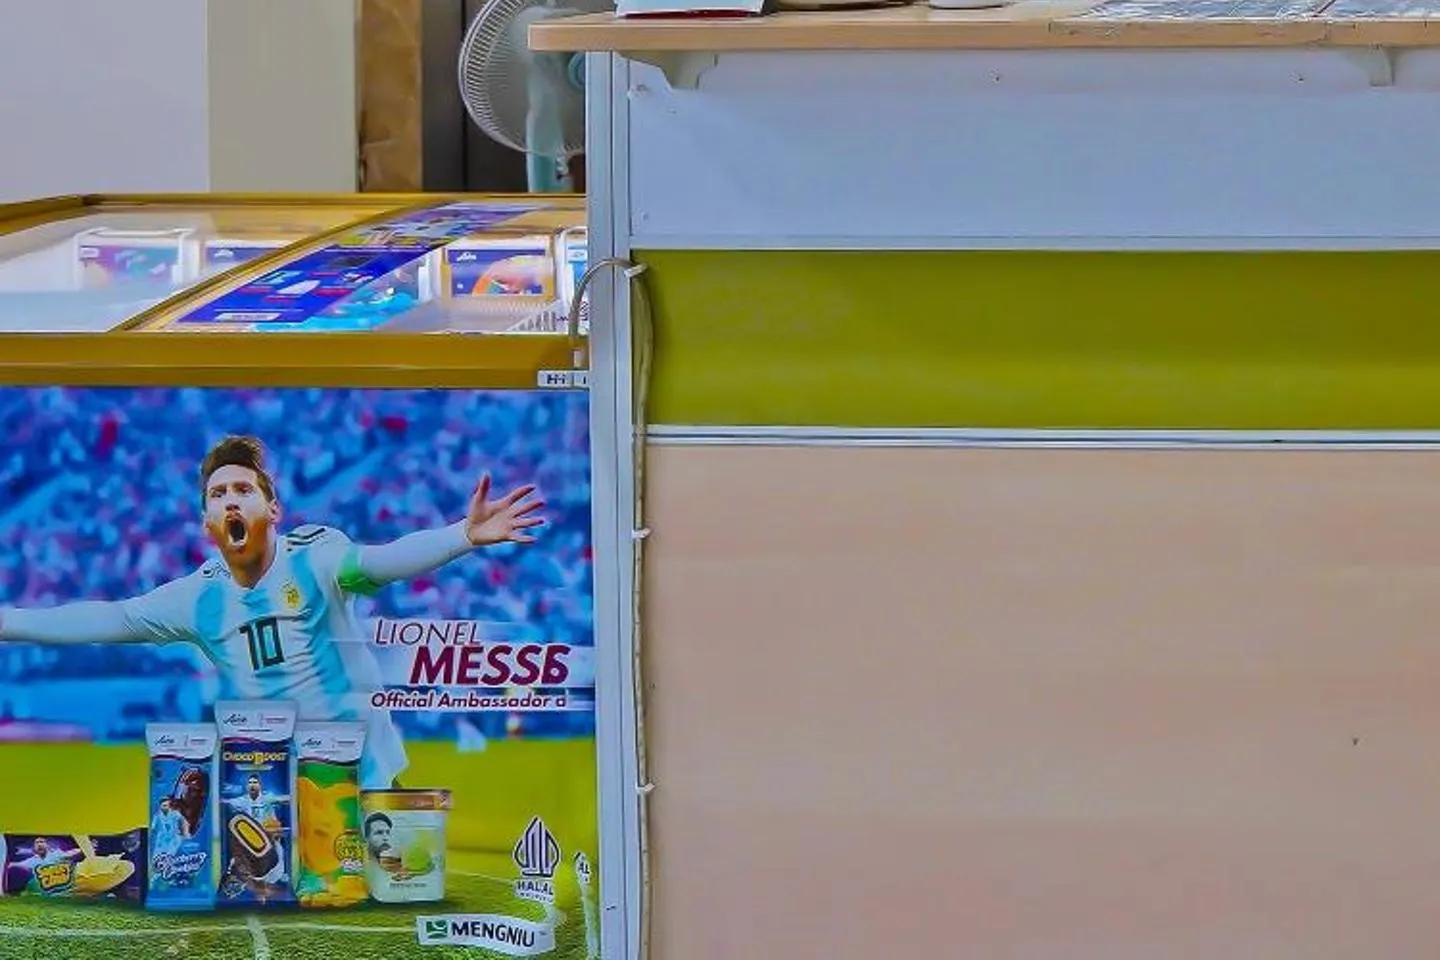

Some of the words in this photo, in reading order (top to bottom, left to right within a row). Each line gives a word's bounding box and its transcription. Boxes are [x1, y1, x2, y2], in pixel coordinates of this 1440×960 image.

[238, 617, 285, 670] 10
[376, 618, 481, 646] LIONEL
[372, 692, 433, 708] Official
[437, 693, 552, 708] Ambassador
[517, 880, 554, 896] HALAL
[451, 921, 536, 948] MENGNIU
